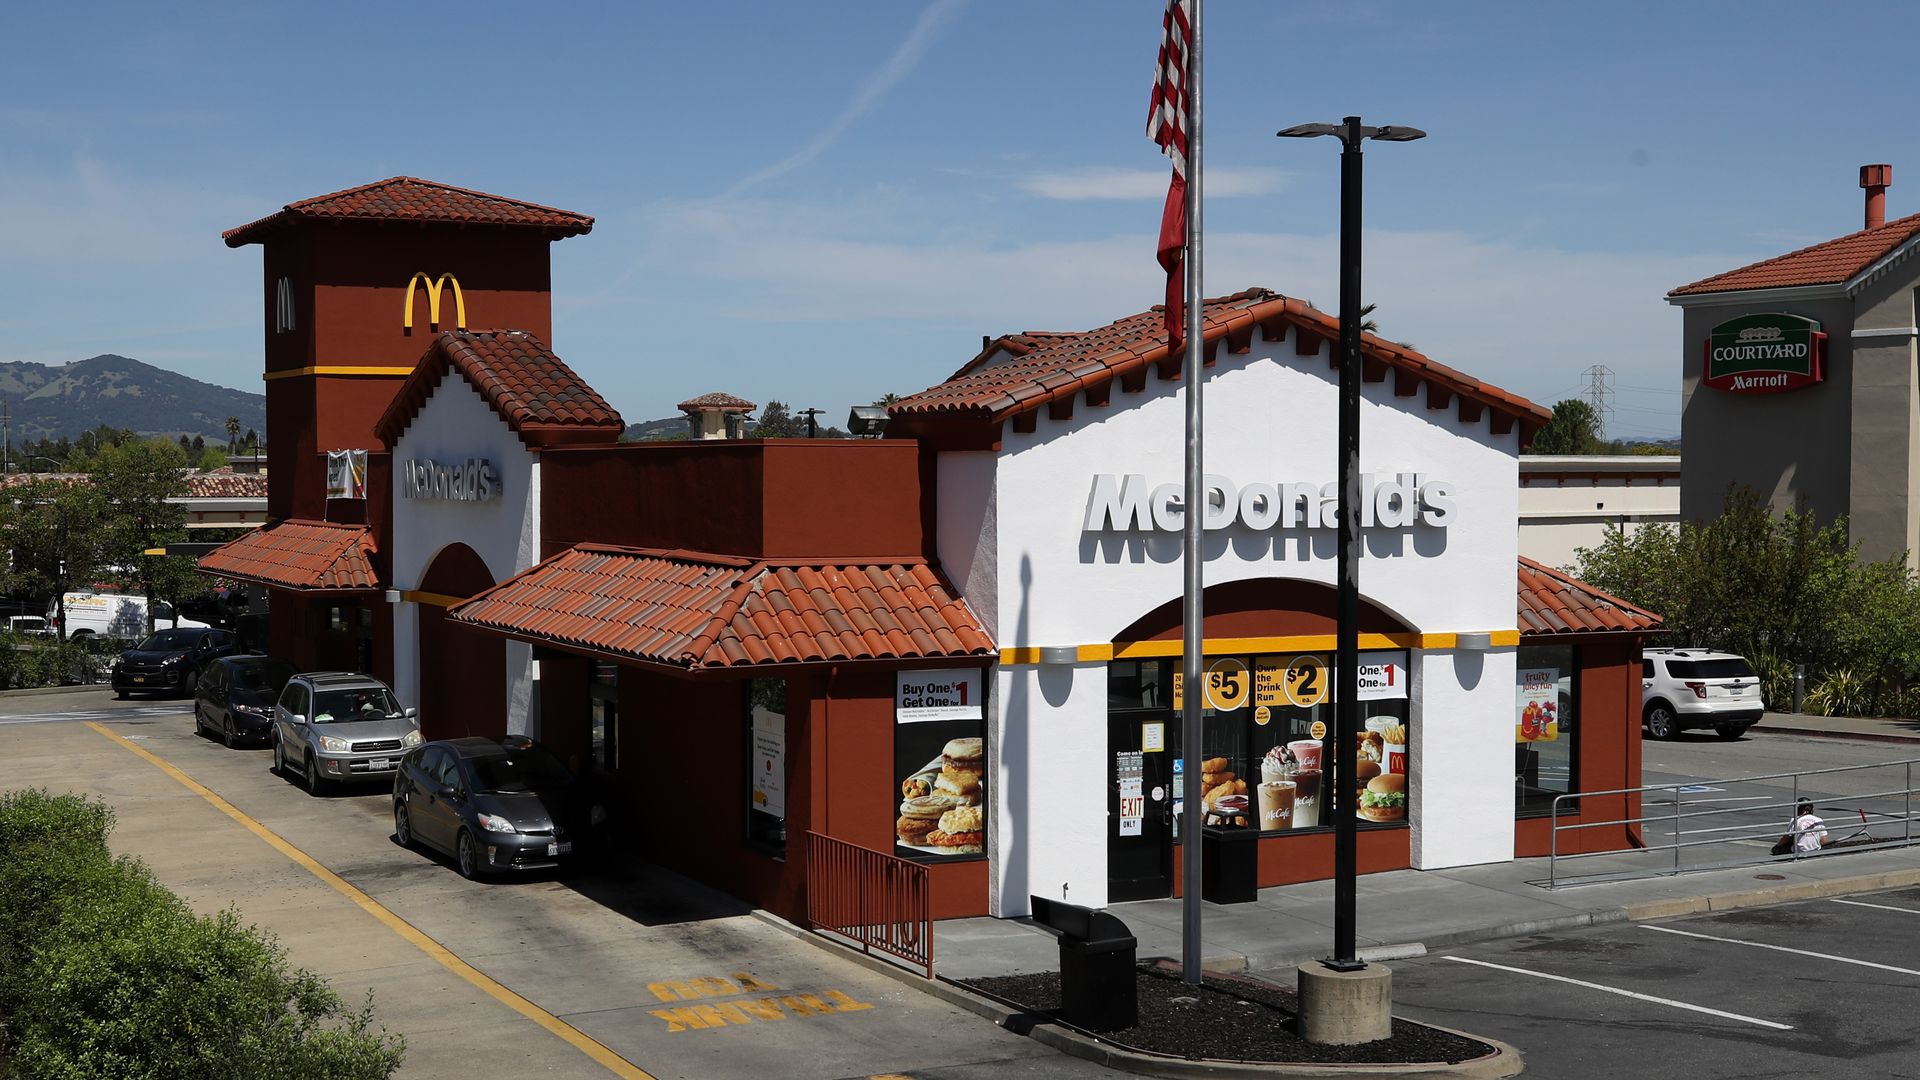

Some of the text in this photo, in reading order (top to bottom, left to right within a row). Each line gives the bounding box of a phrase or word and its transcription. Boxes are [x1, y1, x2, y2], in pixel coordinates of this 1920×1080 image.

[1713, 343, 1808, 361] COURTYARD
[1730, 373, 1788, 391] Marriott
[404, 457, 492, 502] McDonald's
[1257, 664, 1276, 673] Own
[1257, 673, 1271, 682] the
[1287, 664, 1318, 697] $2
[1526, 671, 1551, 682] fruity
[1211, 670, 1240, 700] $5
[1257, 682, 1281, 692] Drink
[1359, 678, 1378, 688] One
[1540, 682, 1553, 690] fun
[903, 684, 925, 697] Buy
[903, 697, 923, 708] Get
[926, 697, 949, 708] One
[1257, 693, 1274, 701] Run
[1121, 797, 1143, 817] EXIT
[1123, 820, 1136, 829] ONLY
[647, 989, 876, 1033] THANK
